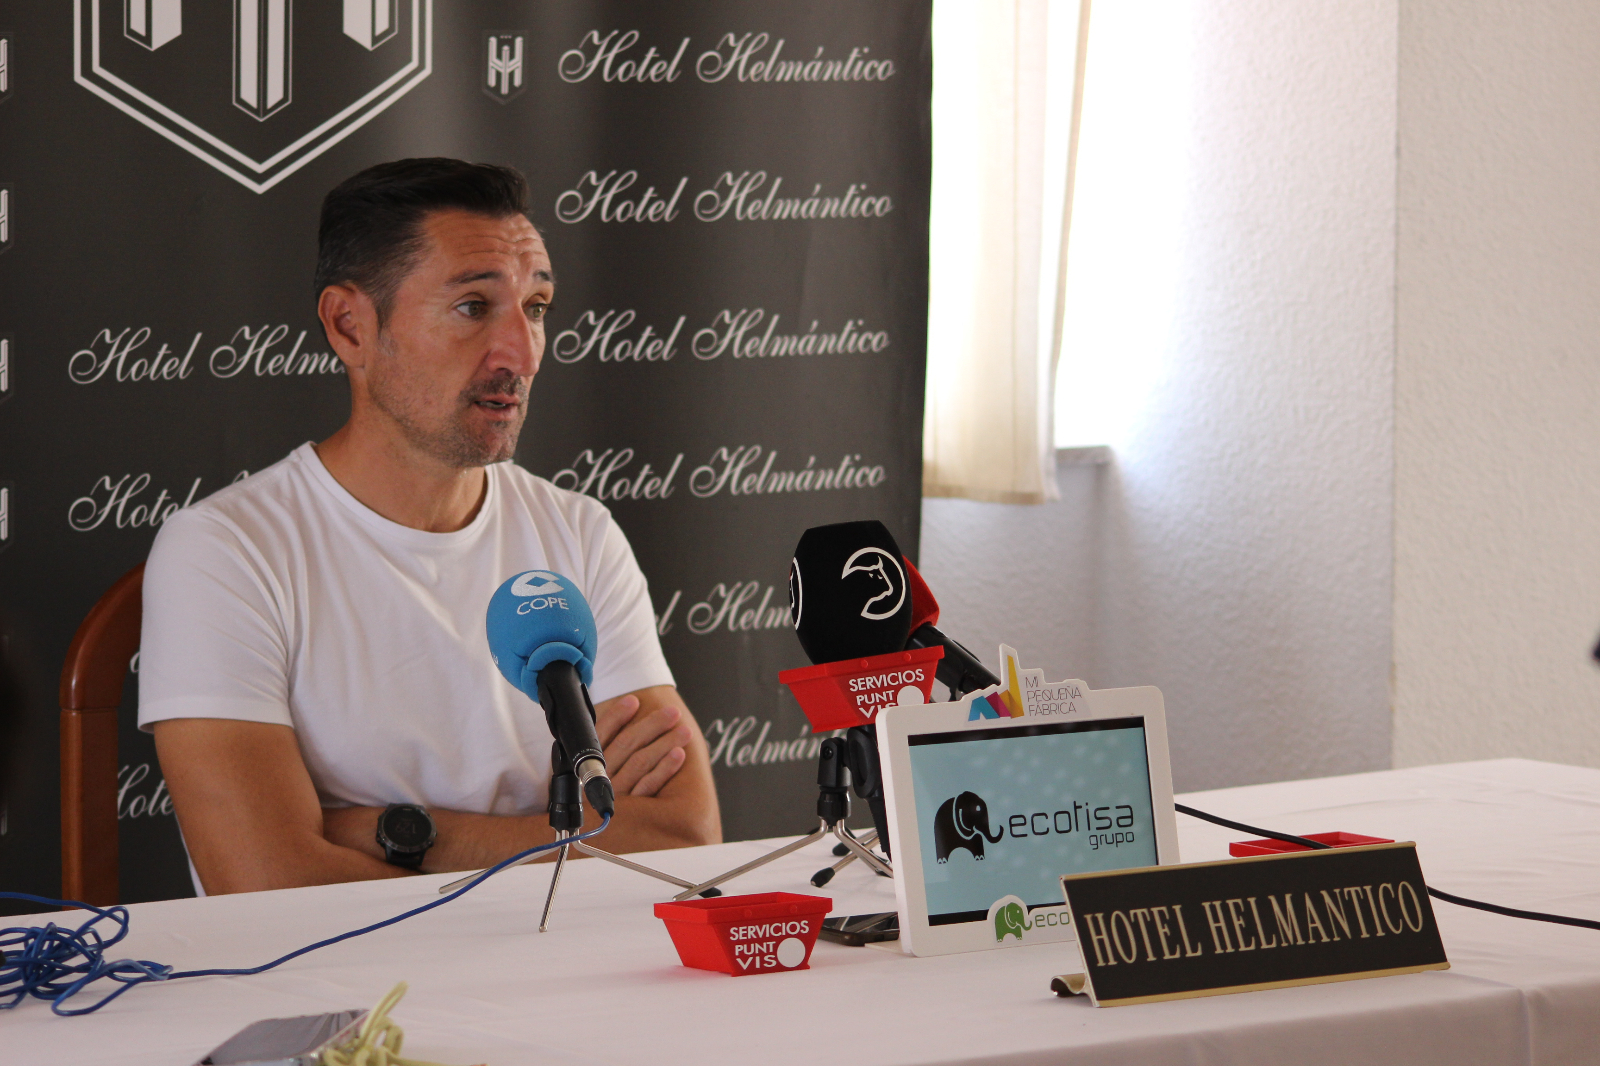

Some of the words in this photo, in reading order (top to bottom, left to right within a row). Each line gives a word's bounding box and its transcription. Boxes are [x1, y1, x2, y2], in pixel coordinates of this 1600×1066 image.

[558, 30, 690, 83] Hotel
[696, 32, 895, 83] Helmántico
[555, 170, 688, 223] Hotel
[693, 171, 892, 222] Helmántico
[552, 309, 686, 364] Hotel
[691, 308, 889, 360] Helmántico
[68, 327, 202, 384] Hotel
[551, 448, 684, 500] Hotel
[689, 445, 885, 497] Helmántico
[516, 597, 569, 615] COPE
[849, 668, 925, 691] SERVICIOS
[1025, 676, 1039, 688] MI
[1026, 686, 1082, 703] PEQUEÑA
[1029, 700, 1077, 717] FÁBRICA
[1008, 800, 1134, 838] ecotisa
[1089, 831, 1135, 850] grupo
[729, 920, 810, 941] SERVICIOS
[1084, 904, 1202, 967] HOTEL
[1202, 881, 1423, 955] HELMANTICO
